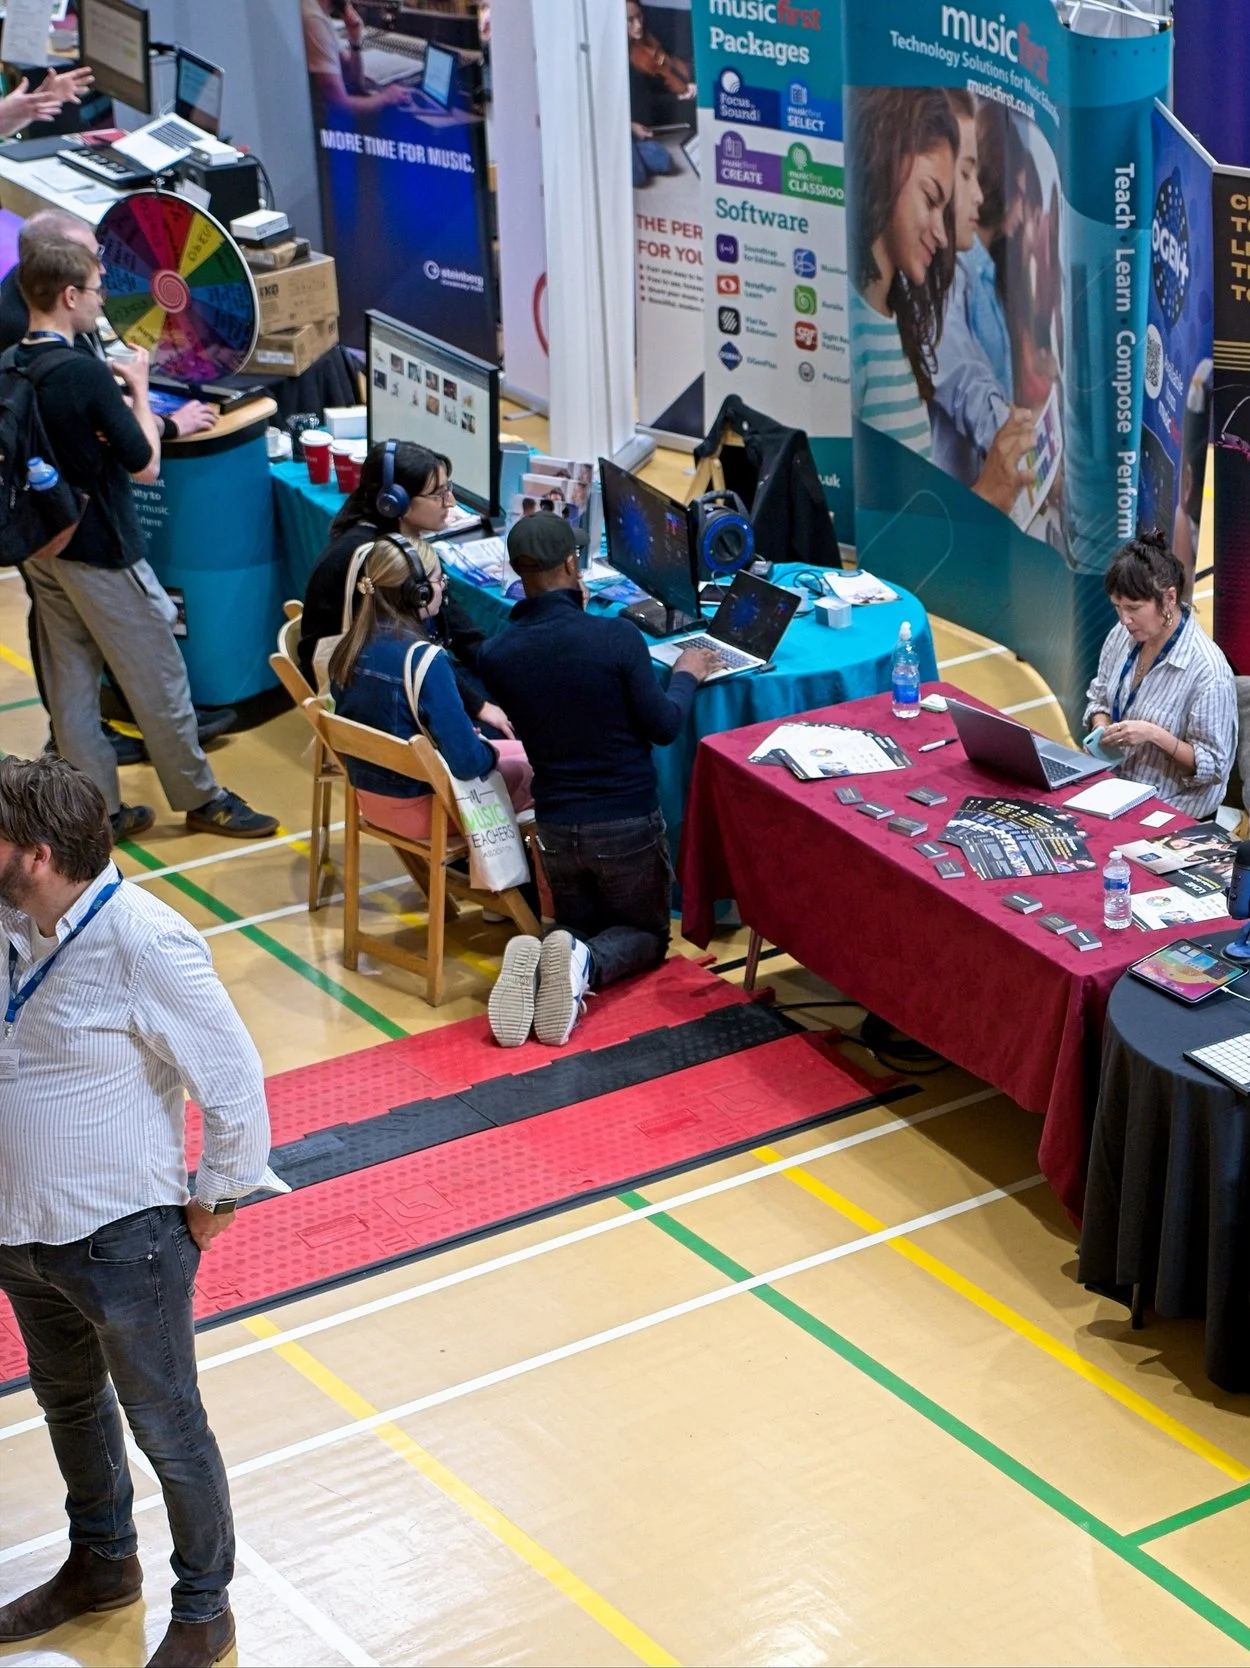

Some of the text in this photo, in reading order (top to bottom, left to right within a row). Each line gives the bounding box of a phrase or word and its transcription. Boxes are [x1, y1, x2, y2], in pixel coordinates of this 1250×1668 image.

[709, 26, 811, 67] Packages
[889, 29, 961, 69] Technology
[962, 51, 1009, 83] Solutions
[1010, 69, 1023, 90] for
[941, 4, 1049, 86] musicfirst
[720, 93, 751, 108] Focus
[720, 105, 757, 121] Sound
[966, 78, 1036, 121] musicfirst.co.uk
[787, 115, 825, 132] SELECT
[320, 128, 475, 174] MORE TIME FOR MUSIC.
[721, 168, 763, 185] CREATE
[788, 180, 844, 200] CLASSROO
[1114, 163, 1135, 230] Teach
[636, 213, 703, 240] THE PER
[715, 197, 809, 234] Software
[637, 239, 671, 260] FOR
[441, 269, 484, 287] steinberg
[1114, 248, 1135, 312] Learn
[1115, 330, 1136, 433] Compose
[1116, 451, 1136, 539] Perform
[468, 825, 515, 849] EACHERS
